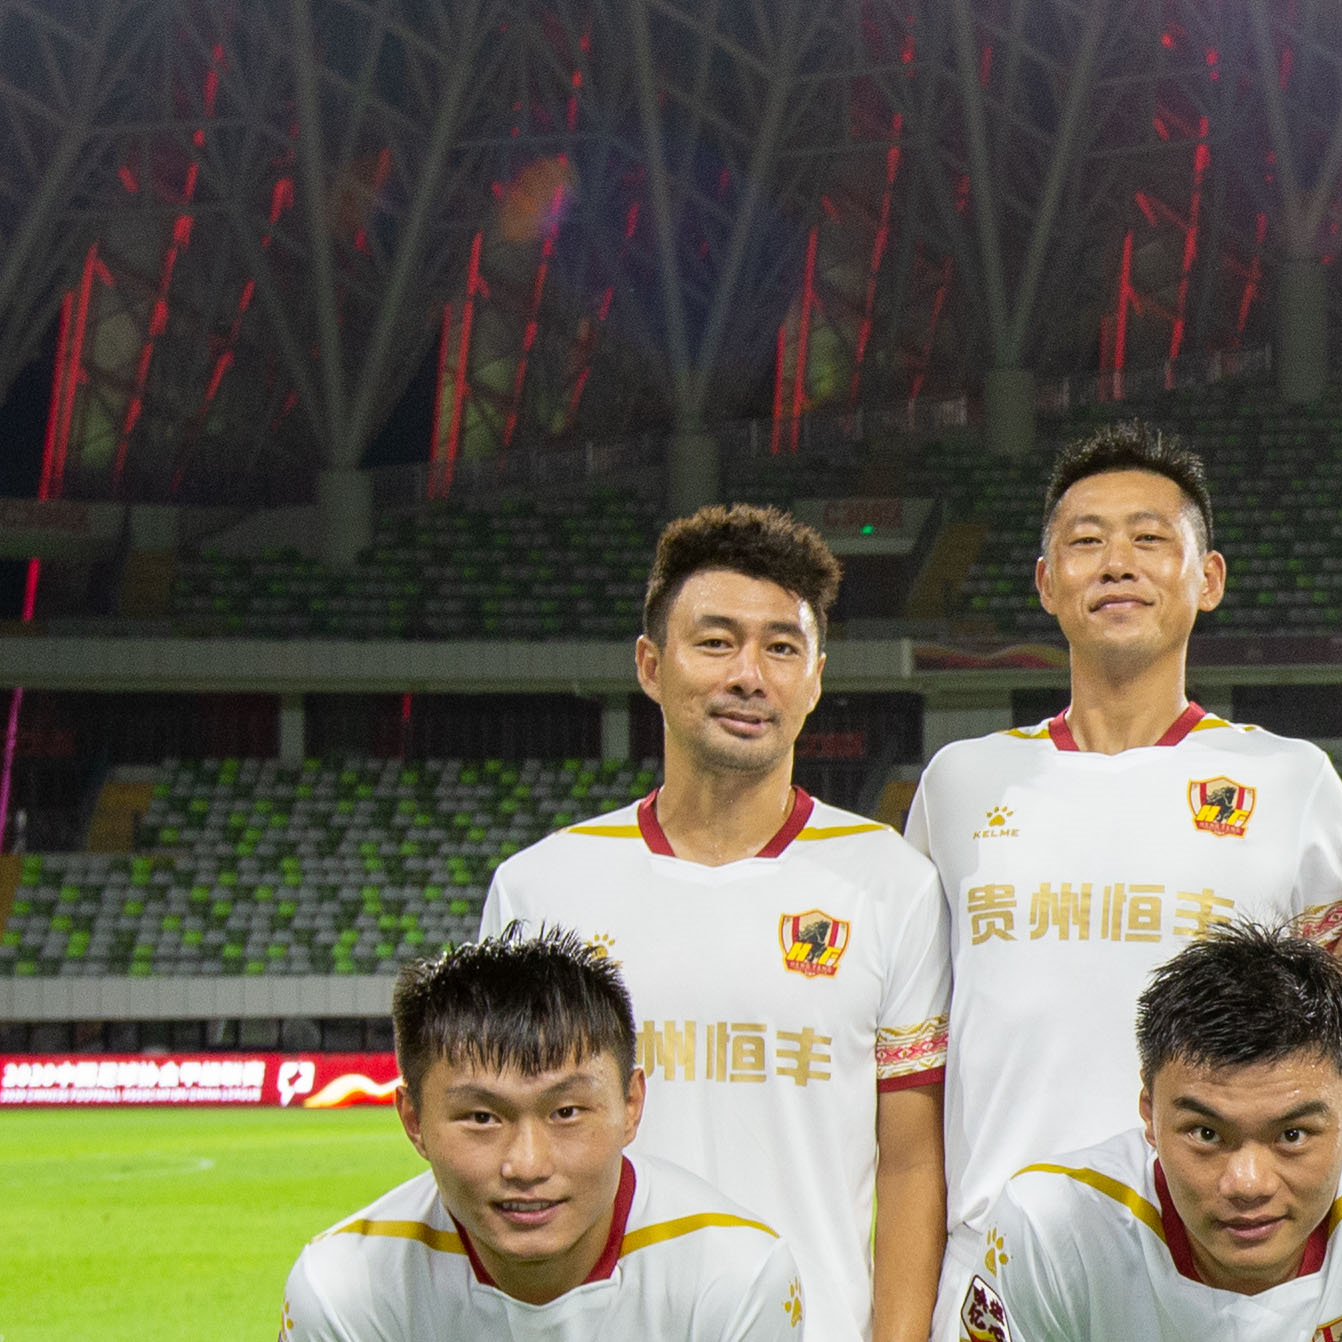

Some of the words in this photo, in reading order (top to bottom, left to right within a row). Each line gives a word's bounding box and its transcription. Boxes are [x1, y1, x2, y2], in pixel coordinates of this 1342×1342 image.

[973, 829, 1020, 840] KELME
[636, 1020, 832, 1087] 州恒丰
